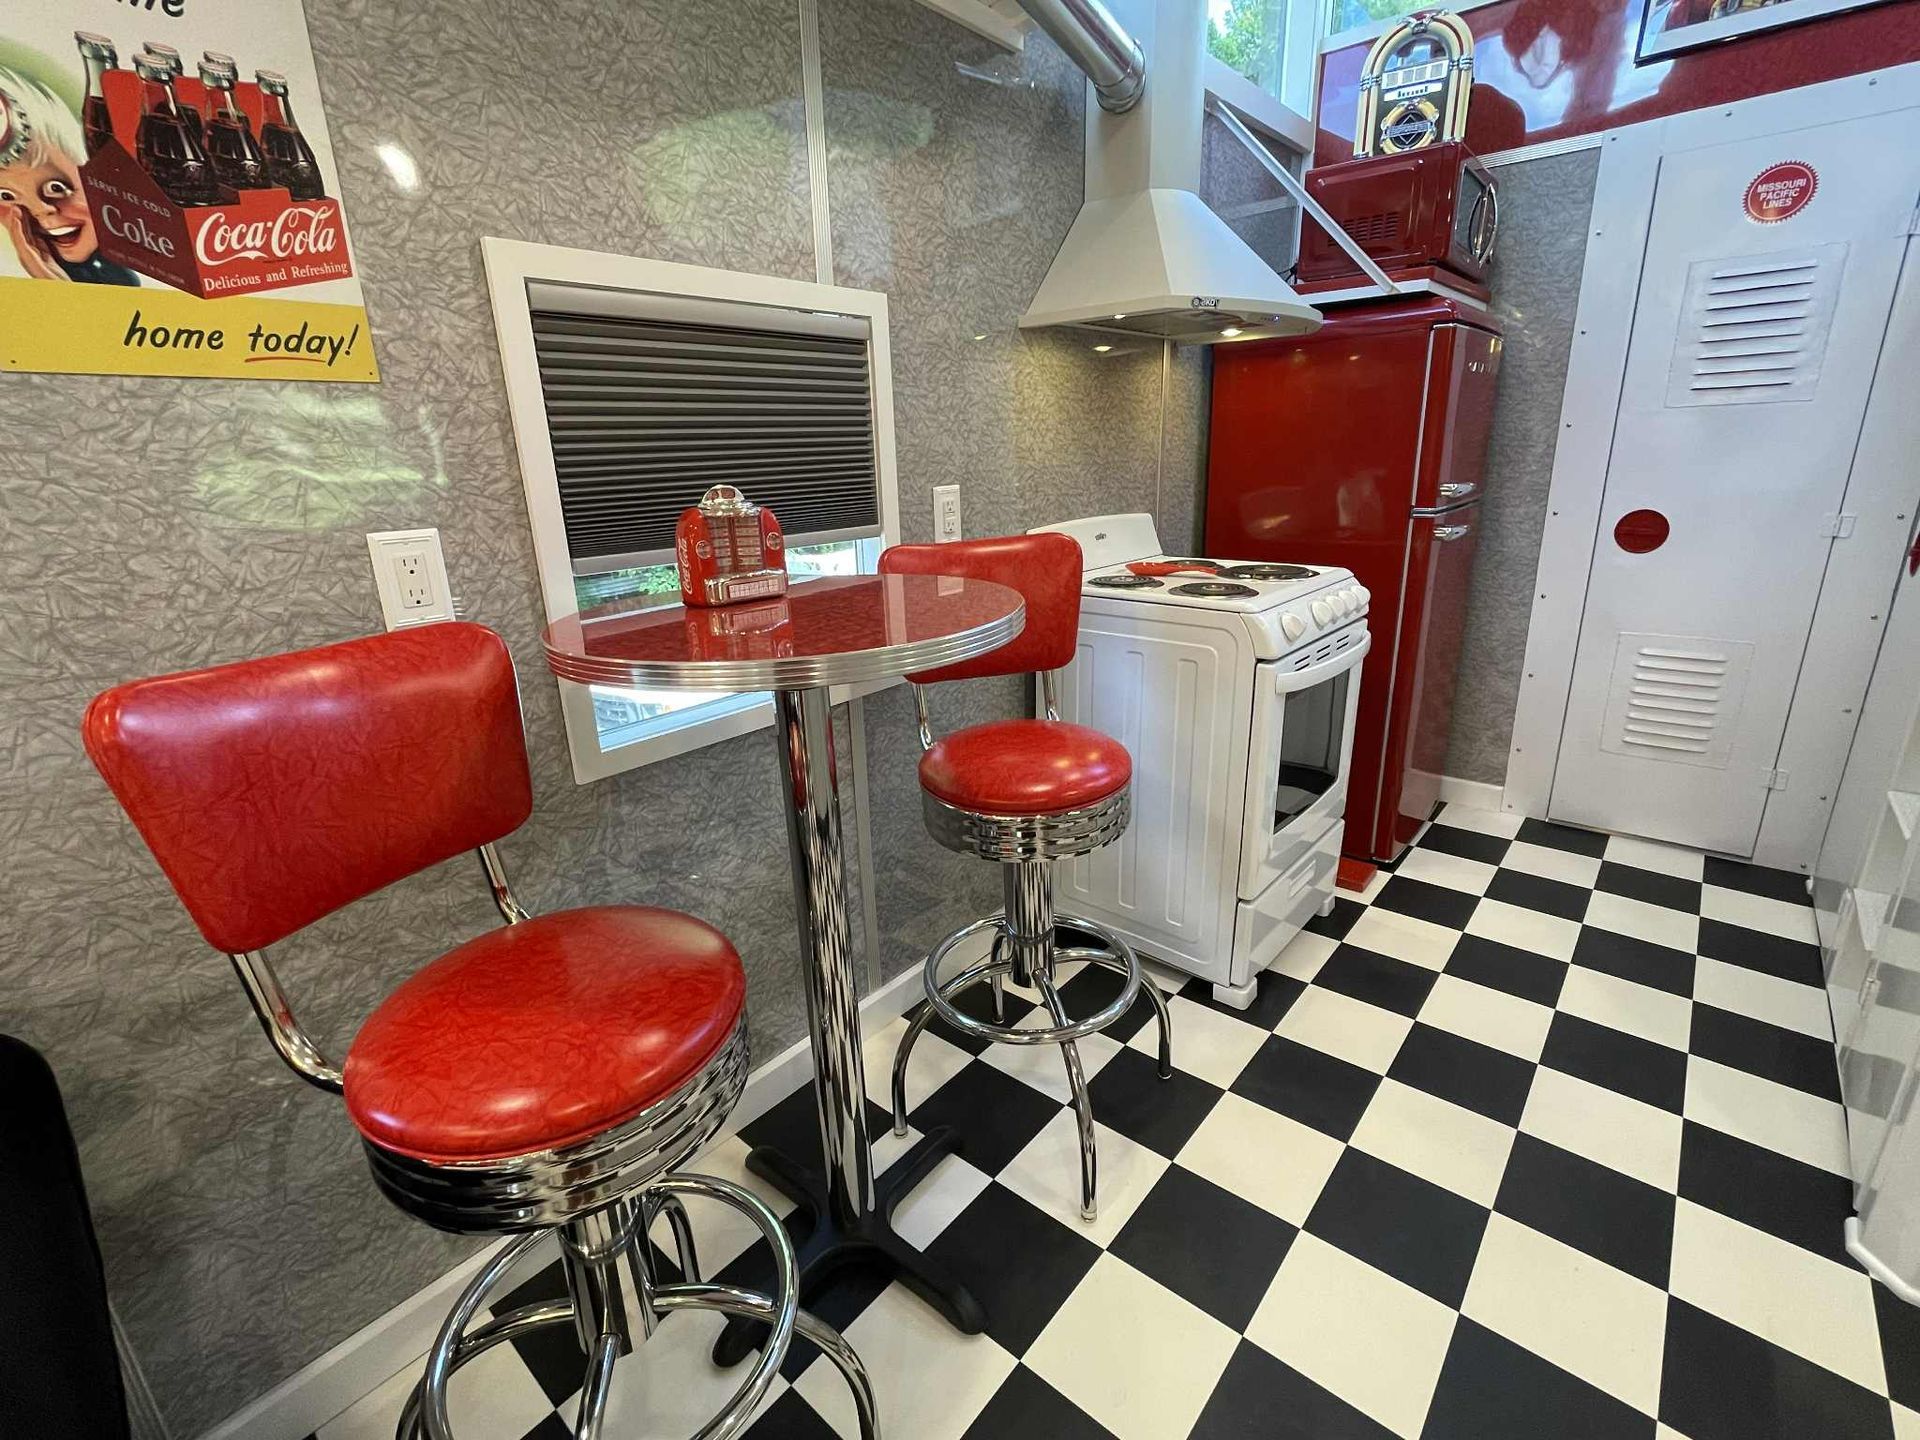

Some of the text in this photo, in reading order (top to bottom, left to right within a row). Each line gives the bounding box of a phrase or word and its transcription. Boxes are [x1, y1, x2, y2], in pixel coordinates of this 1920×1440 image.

[87, 176, 171, 218] SERVE ICE COLD
[1757, 178, 1807, 193] MISSOURI
[1760, 188, 1800, 201] PACIFIC
[1762, 198, 1792, 209] LINES
[102, 204, 175, 258] Coke
[196, 206, 336, 266] Coca-Cola
[204, 261, 349, 292] Delicious and Refreshing
[124, 310, 359, 367] home today!
